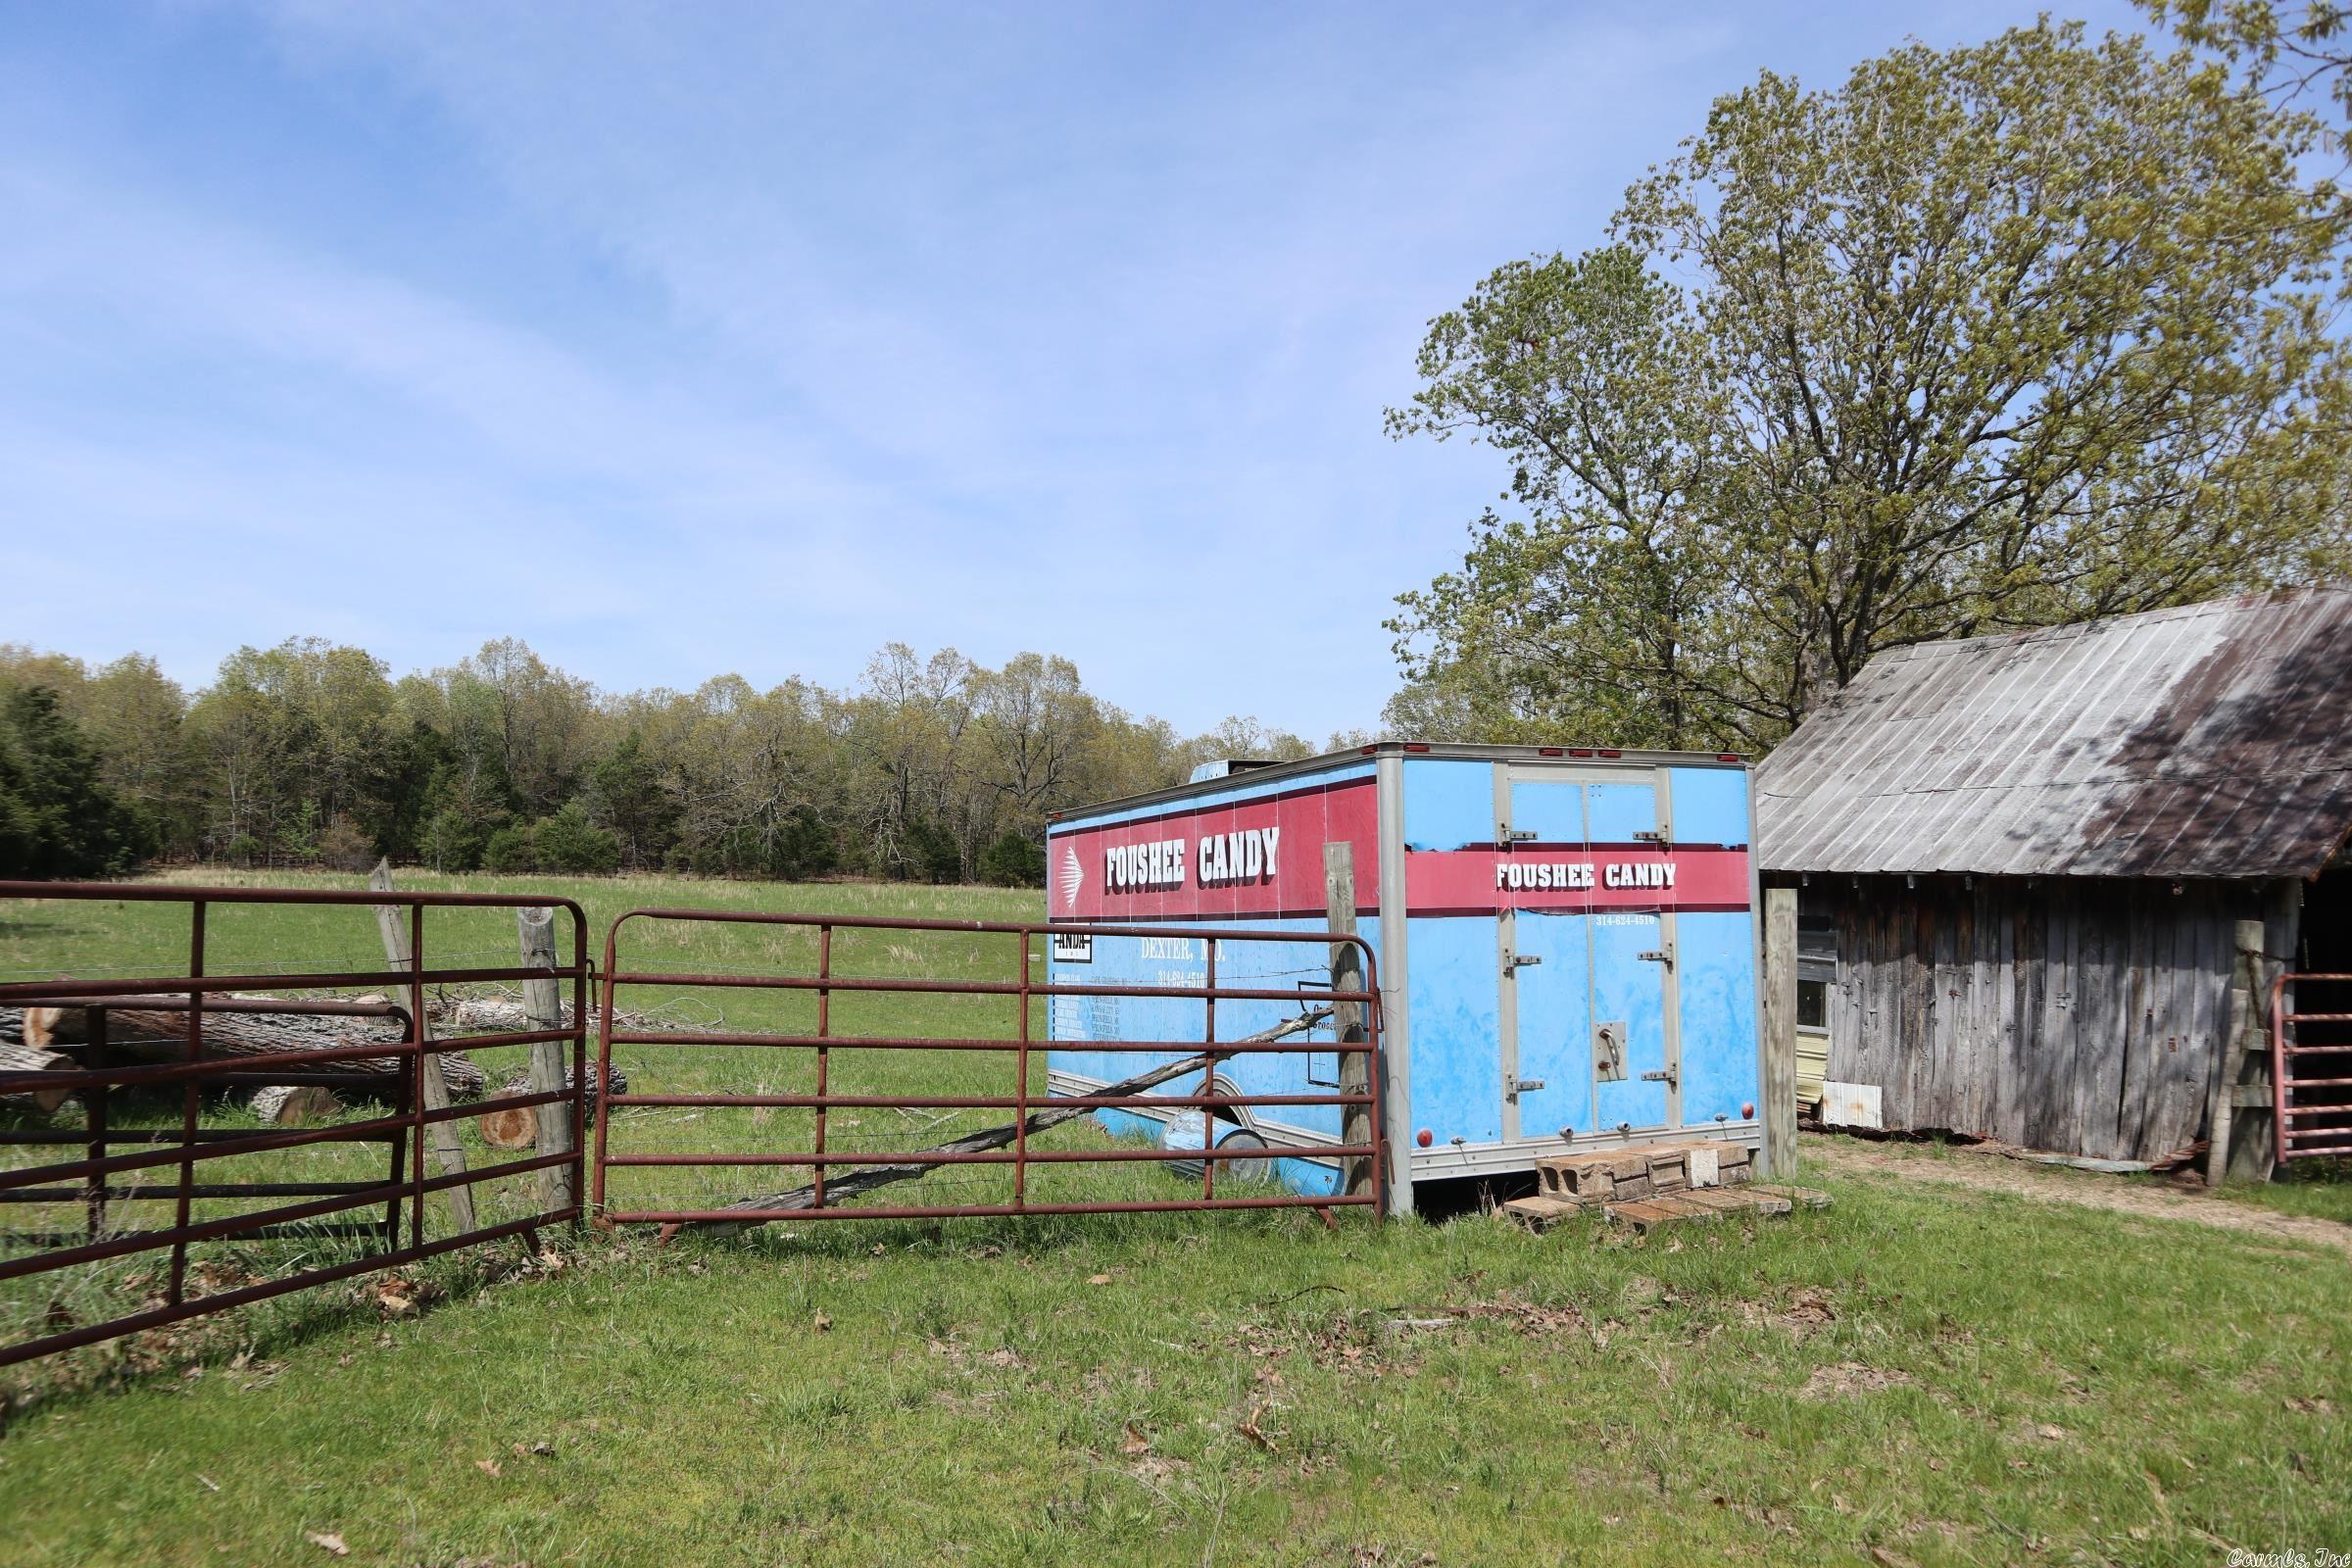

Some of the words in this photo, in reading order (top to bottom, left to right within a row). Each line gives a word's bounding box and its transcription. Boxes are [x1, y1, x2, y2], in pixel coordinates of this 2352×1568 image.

[1106, 838, 1185, 888] FOUSHEE
[1199, 826, 1280, 885] CANDY
[1496, 862, 1595, 889] FOUSHEE
[1604, 862, 1677, 887] CANDY
[1595, 914, 1655, 926] 314-624-4510
[1141, 937, 1194, 962] DEXTER,
